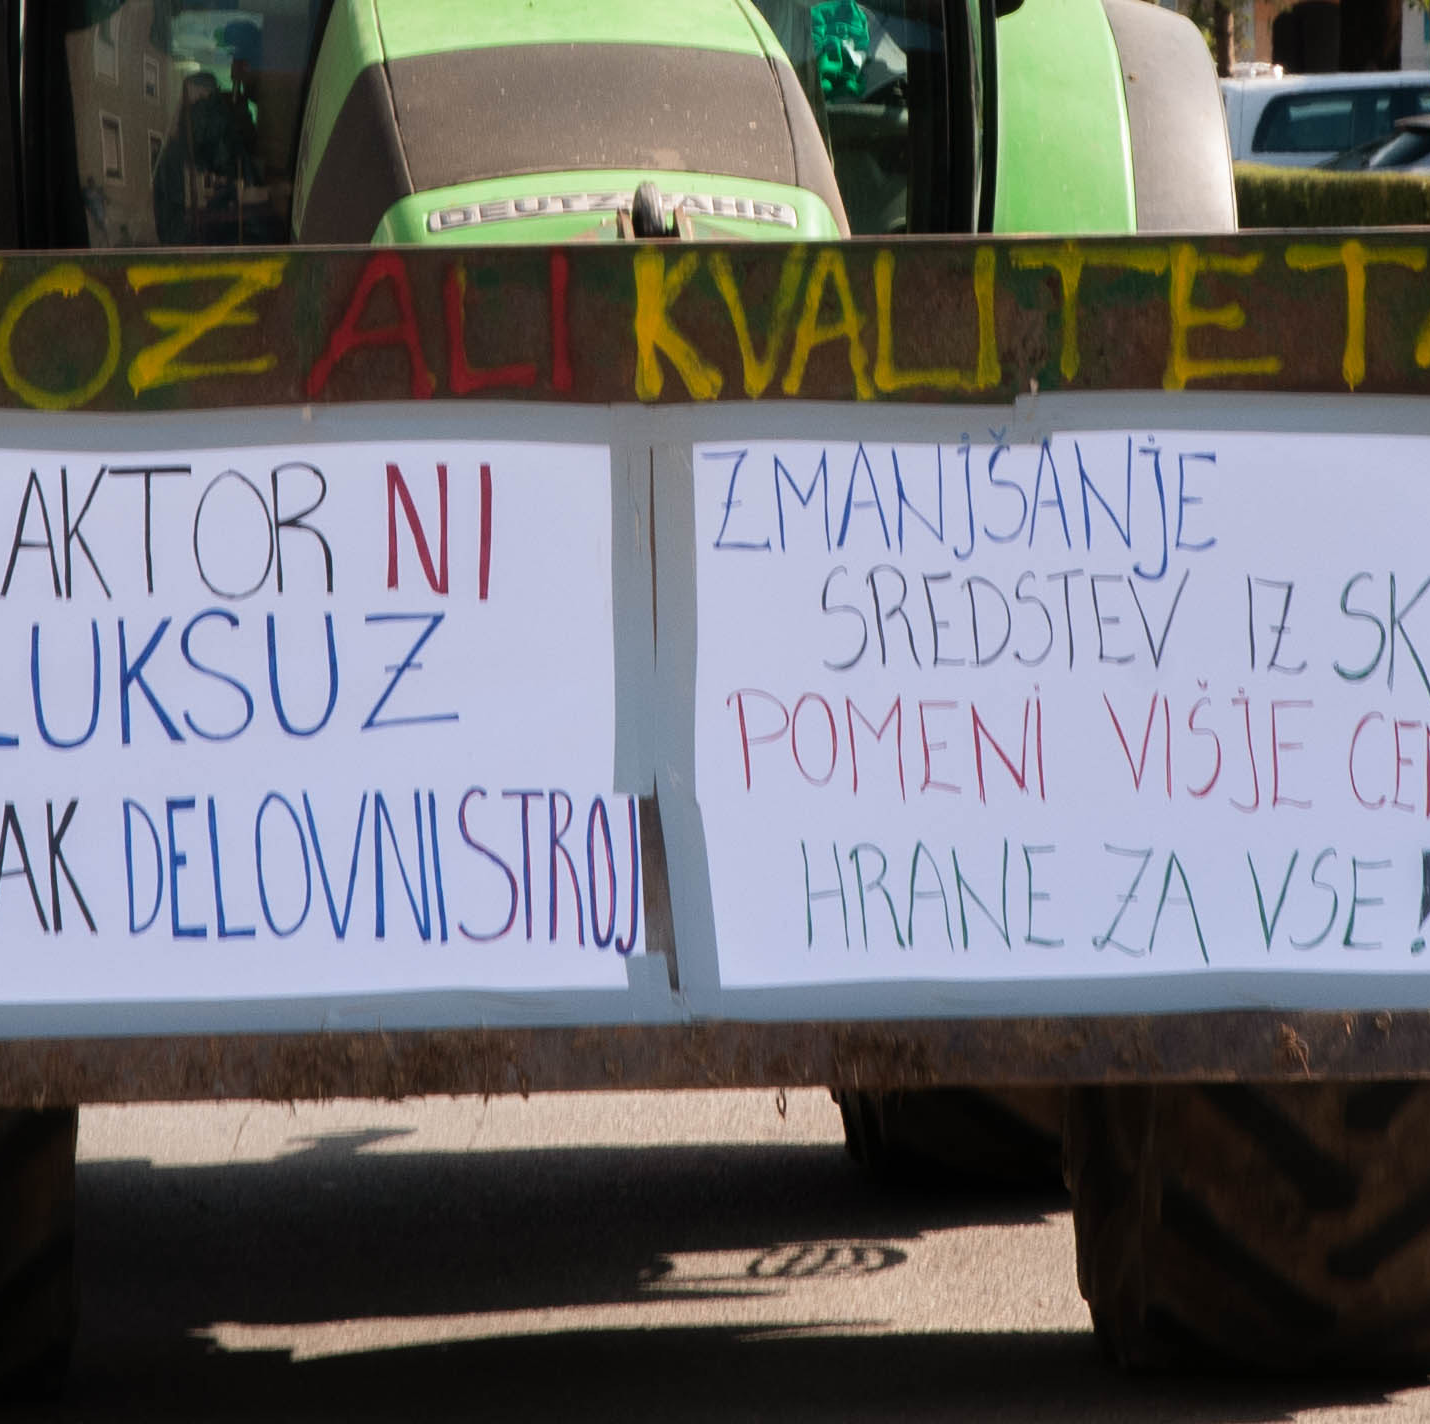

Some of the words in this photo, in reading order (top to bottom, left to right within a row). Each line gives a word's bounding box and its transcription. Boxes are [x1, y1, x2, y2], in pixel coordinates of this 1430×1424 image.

[306, 248, 571, 399] ALI
[385, 462, 493, 601] NI
[701, 428, 1217, 581] ZMANJŠANJE
[821, 564, 1190, 673] SREDSTEV
[1246, 572, 1308, 674] IZ
[1102, 679, 1314, 814] VIŠJE
[799, 838, 1065, 952] HRANE
[1091, 842, 1210, 966] ZA
